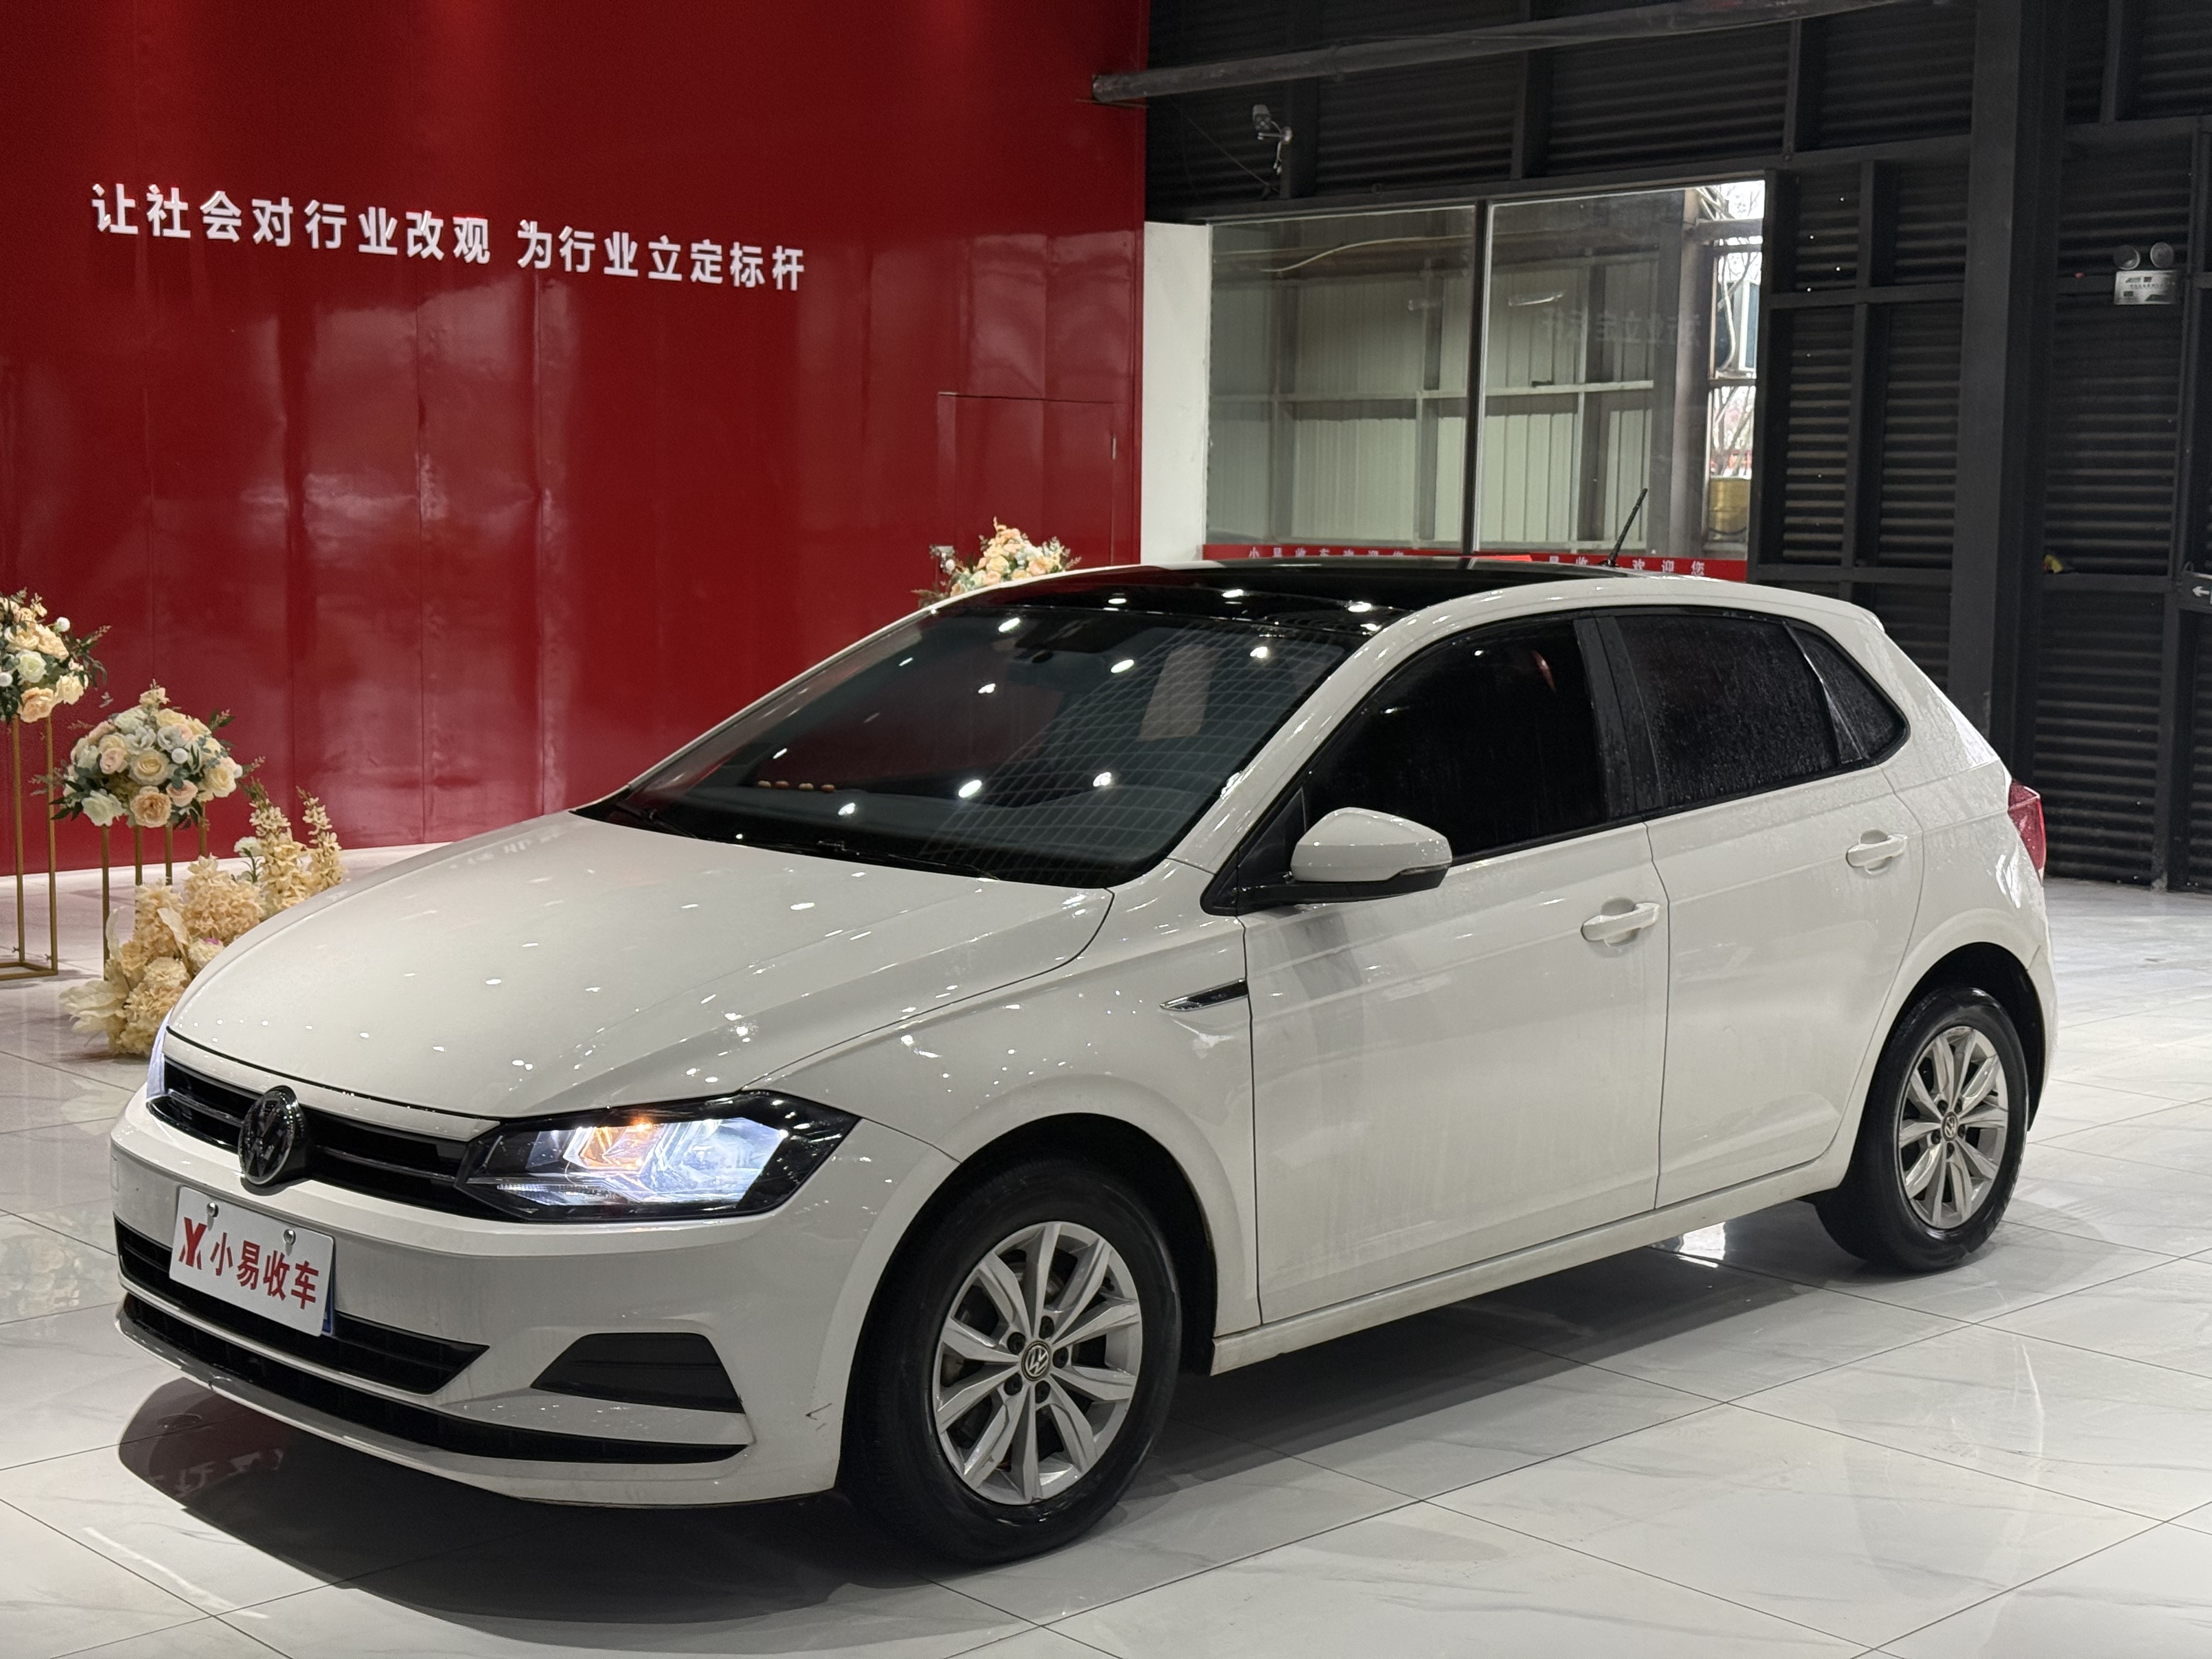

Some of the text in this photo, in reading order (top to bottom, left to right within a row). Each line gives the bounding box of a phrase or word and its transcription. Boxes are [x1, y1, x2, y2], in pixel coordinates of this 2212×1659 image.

[90, 182, 805, 291] 让社会对行业改观 为行业立定标杆
[210, 1232, 319, 1310] 小易收车
